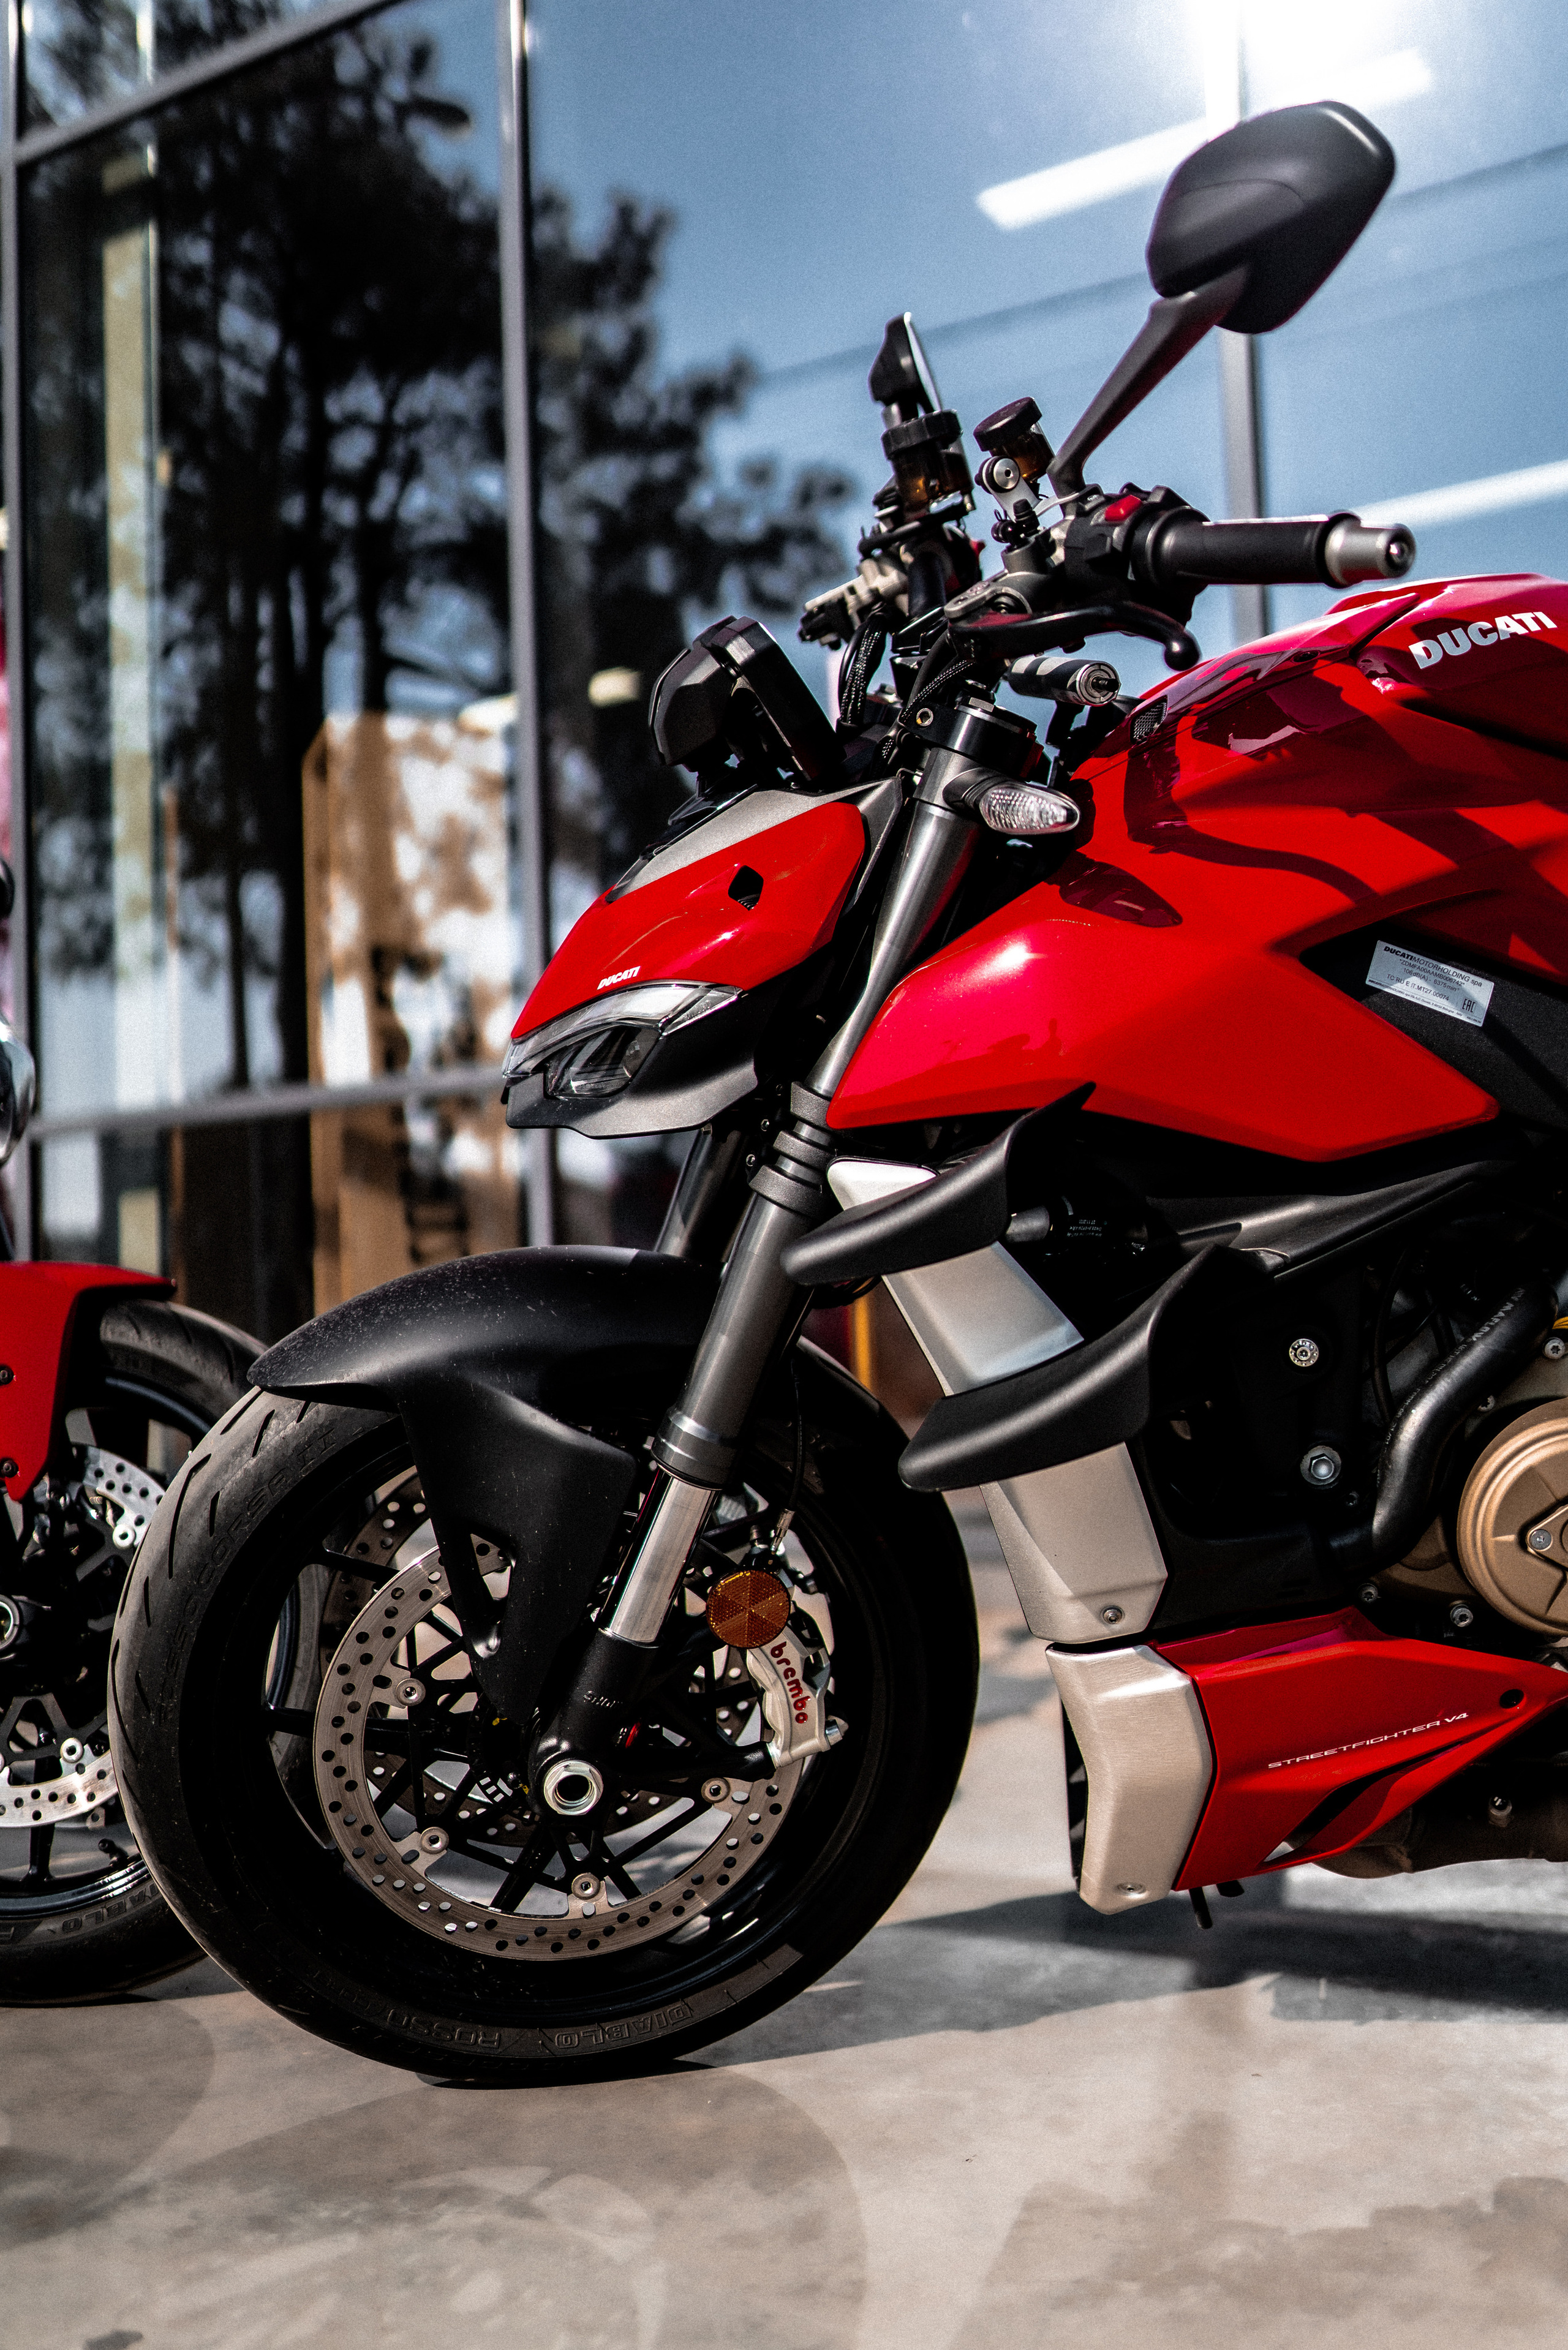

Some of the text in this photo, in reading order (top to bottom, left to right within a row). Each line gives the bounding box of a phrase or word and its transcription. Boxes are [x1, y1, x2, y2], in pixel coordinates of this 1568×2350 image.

[1409, 612, 1558, 669] DUCATI
[597, 965, 641, 990] DUCATI
[1469, 979, 1482, 987] spa
[771, 1641, 811, 1724] brembo
[1268, 1712, 1468, 1769] STREETFIGHTER V4
[62, 1882, 159, 1932] IABLO
[386, 2004, 693, 2049] DIABLO ROSSO
